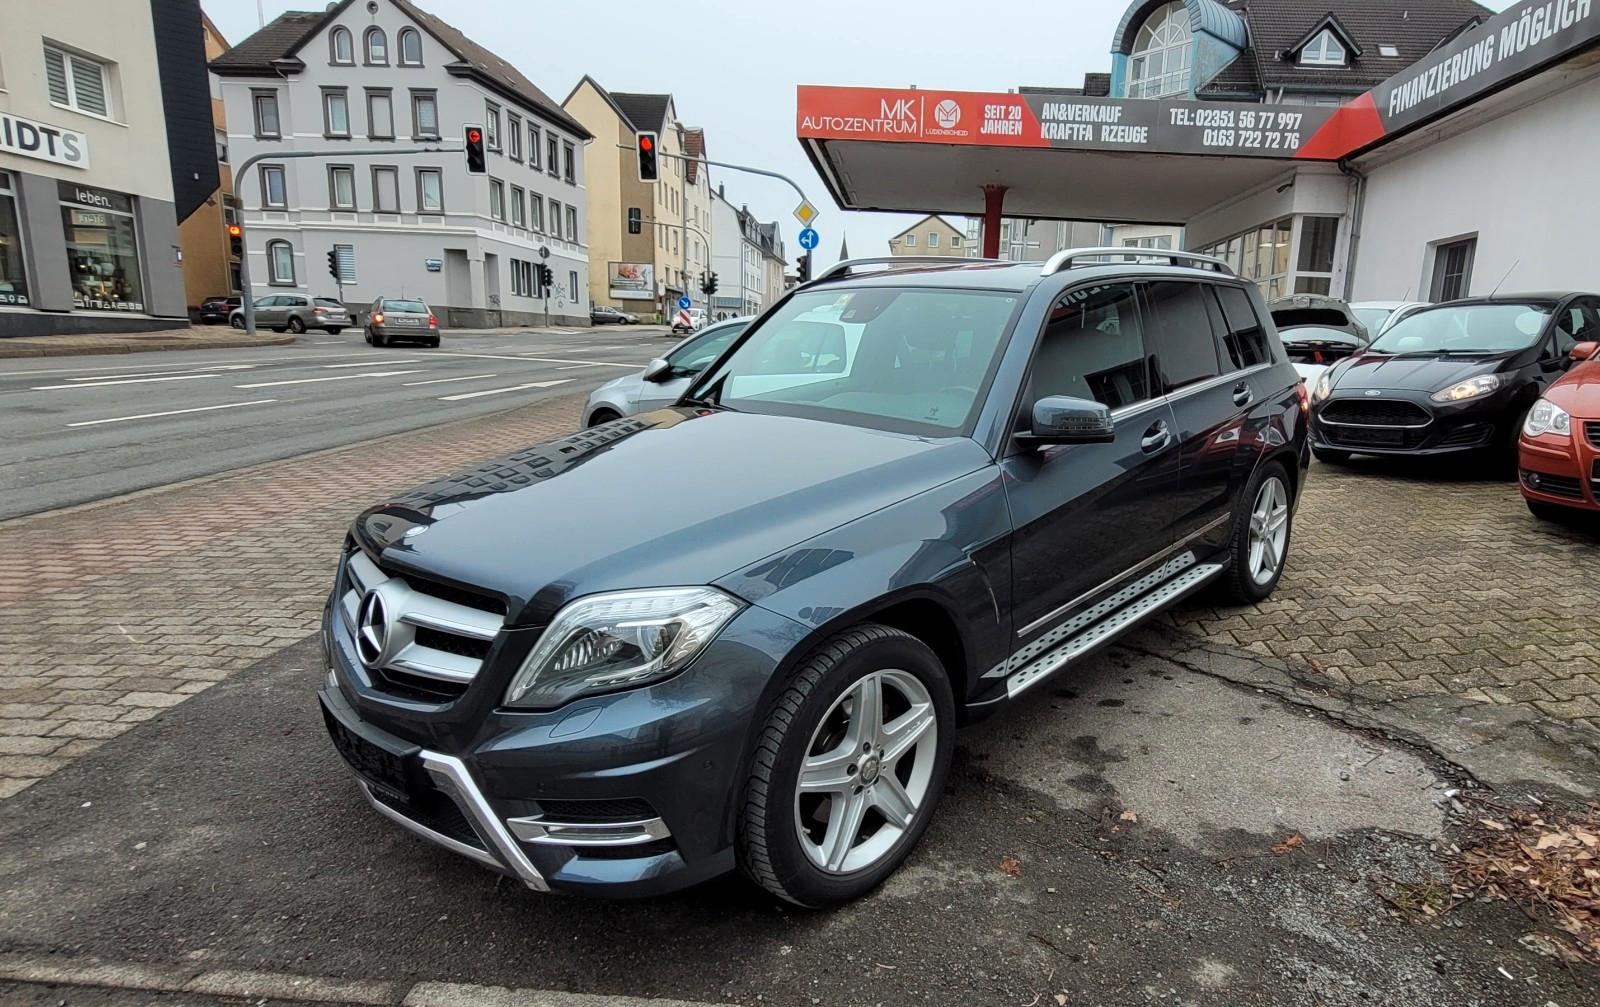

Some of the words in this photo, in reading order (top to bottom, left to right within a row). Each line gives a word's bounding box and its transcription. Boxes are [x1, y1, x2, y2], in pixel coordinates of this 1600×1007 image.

[1388, 34, 1495, 118] FINANZIERUNG
[880, 98, 915, 120] MK
[984, 104, 1005, 119] SEIT
[1008, 106, 1022, 120] 20
[1041, 102, 1122, 123] AN&VERKAUF
[1169, 108, 1195, 126] TEL:
[1195, 109, 1235, 128] 02351
[1238, 111, 1256, 129] 56
[1258, 112, 1276, 129] 77
[1277, 112, 1303, 130] 997
[801, 115, 917, 135] AUTOZENTRUM
[980, 120, 1023, 136] JAHREN
[1040, 122, 1093, 141] KRAFTFA
[1100, 124, 1149, 143] RZEUGE
[0, 117, 82, 162] IDTS
[1203, 129, 1235, 146] 0163
[1238, 130, 1262, 148] 722
[1264, 132, 1281, 149] 72
[1283, 132, 1301, 149] 76
[75, 187, 112, 208] leben.
